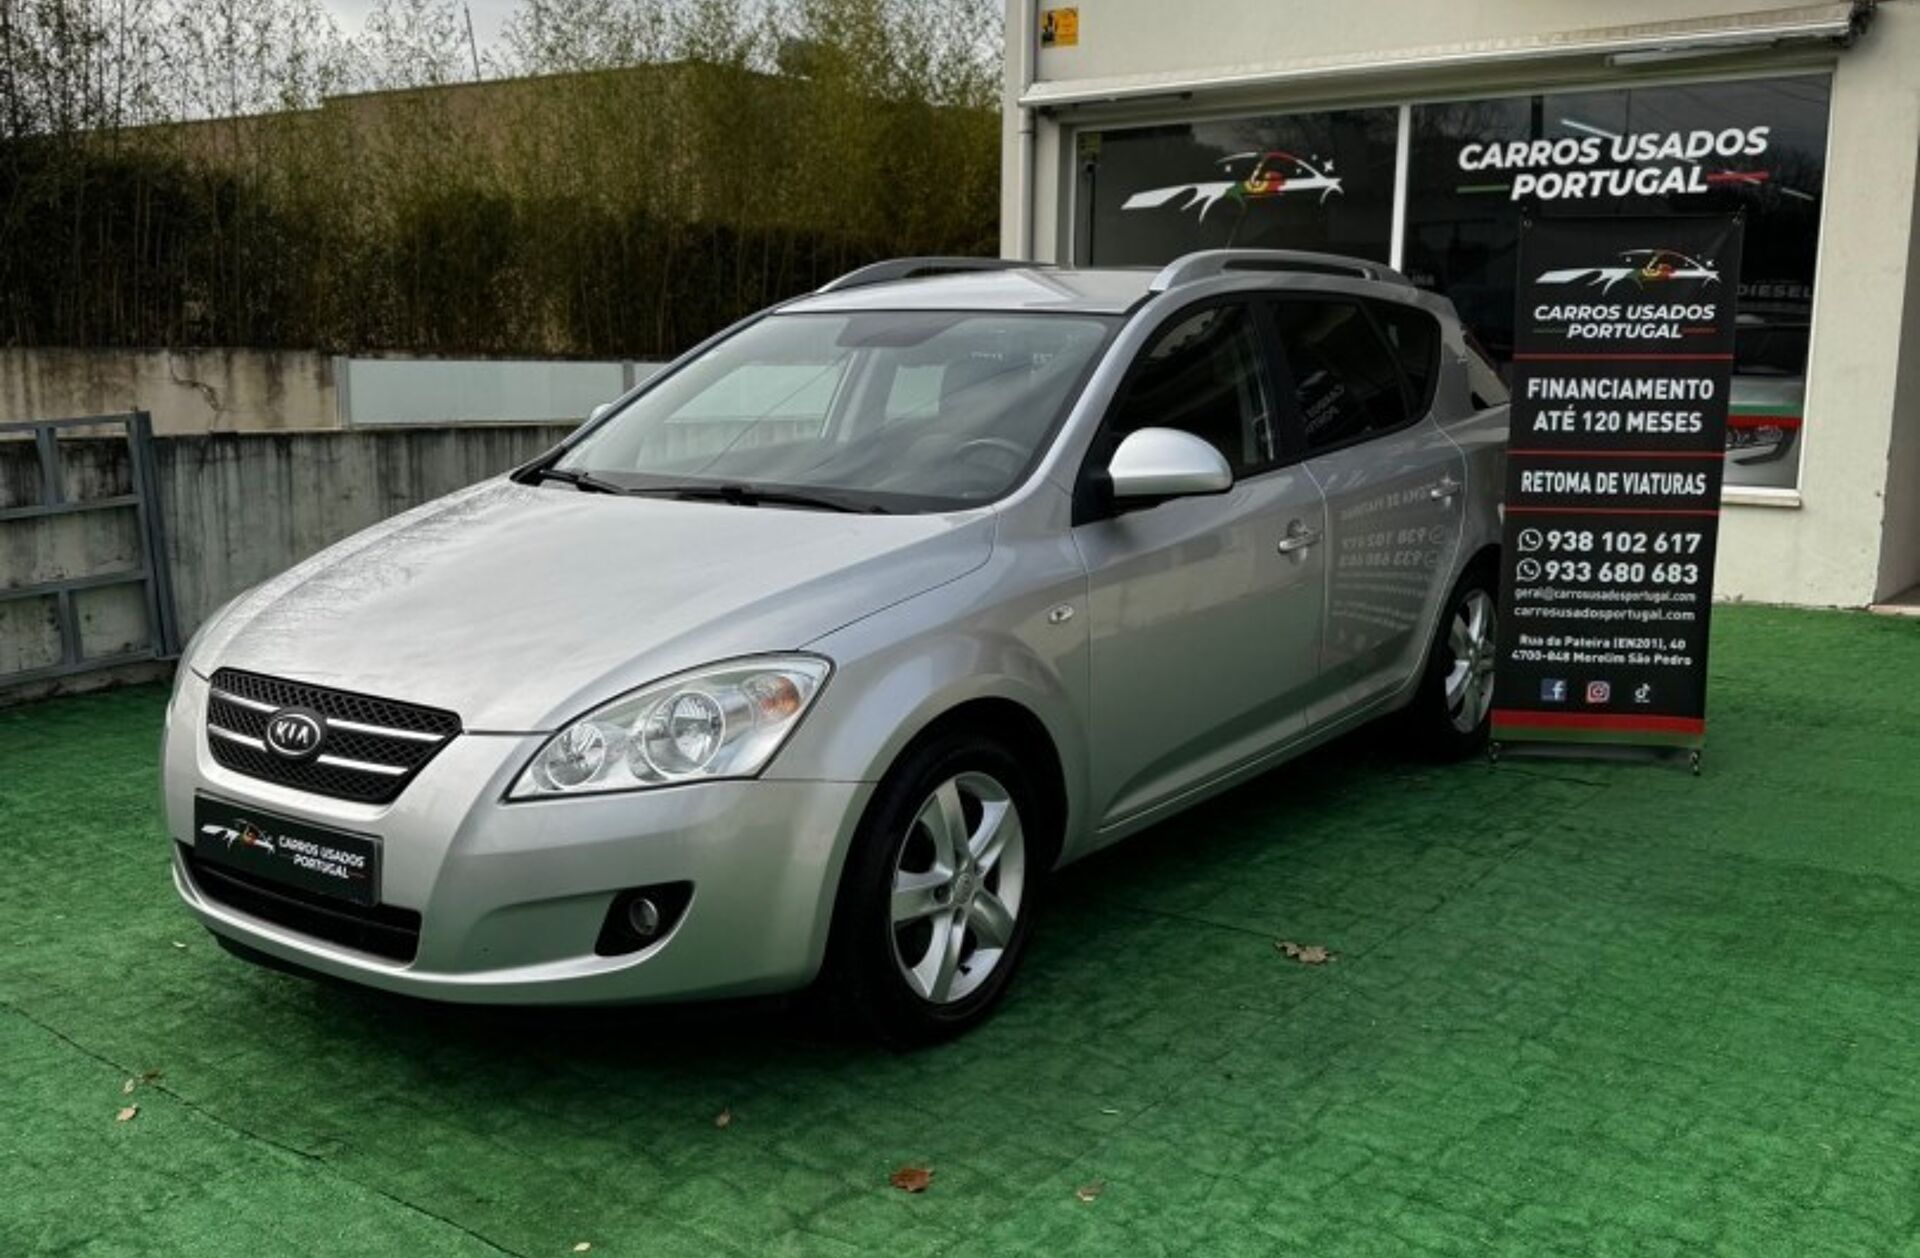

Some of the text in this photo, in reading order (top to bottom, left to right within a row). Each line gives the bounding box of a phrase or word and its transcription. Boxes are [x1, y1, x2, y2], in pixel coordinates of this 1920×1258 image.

[1457, 125, 1772, 171] CARROS USADOS
[1510, 166, 1709, 201] PORTUGAL
[1736, 284, 1811, 299] DIESEL
[1533, 304, 1716, 321] CARROS USADOS
[1566, 322, 1683, 339] PORTUGAL
[1527, 377, 1715, 400] FINANCIAMENTO
[1533, 403, 1703, 433] ATÉ 120 MESES
[1521, 471, 1706, 495] RETOMA DE VIATURAS
[1546, 530, 1702, 554] 938 102 617
[1545, 561, 1699, 585] 933 680 683
[1513, 606, 1696, 622] carrosusadosportugal.com
[1519, 633, 1544, 647] Rua
[1564, 635, 1611, 648] Pateira
[1654, 653, 1693, 666] Pedro
[276, 720, 309, 744] KIA
[278, 835, 366, 869] CARROS USADOS
[293, 853, 350, 879] PORTUGAL
